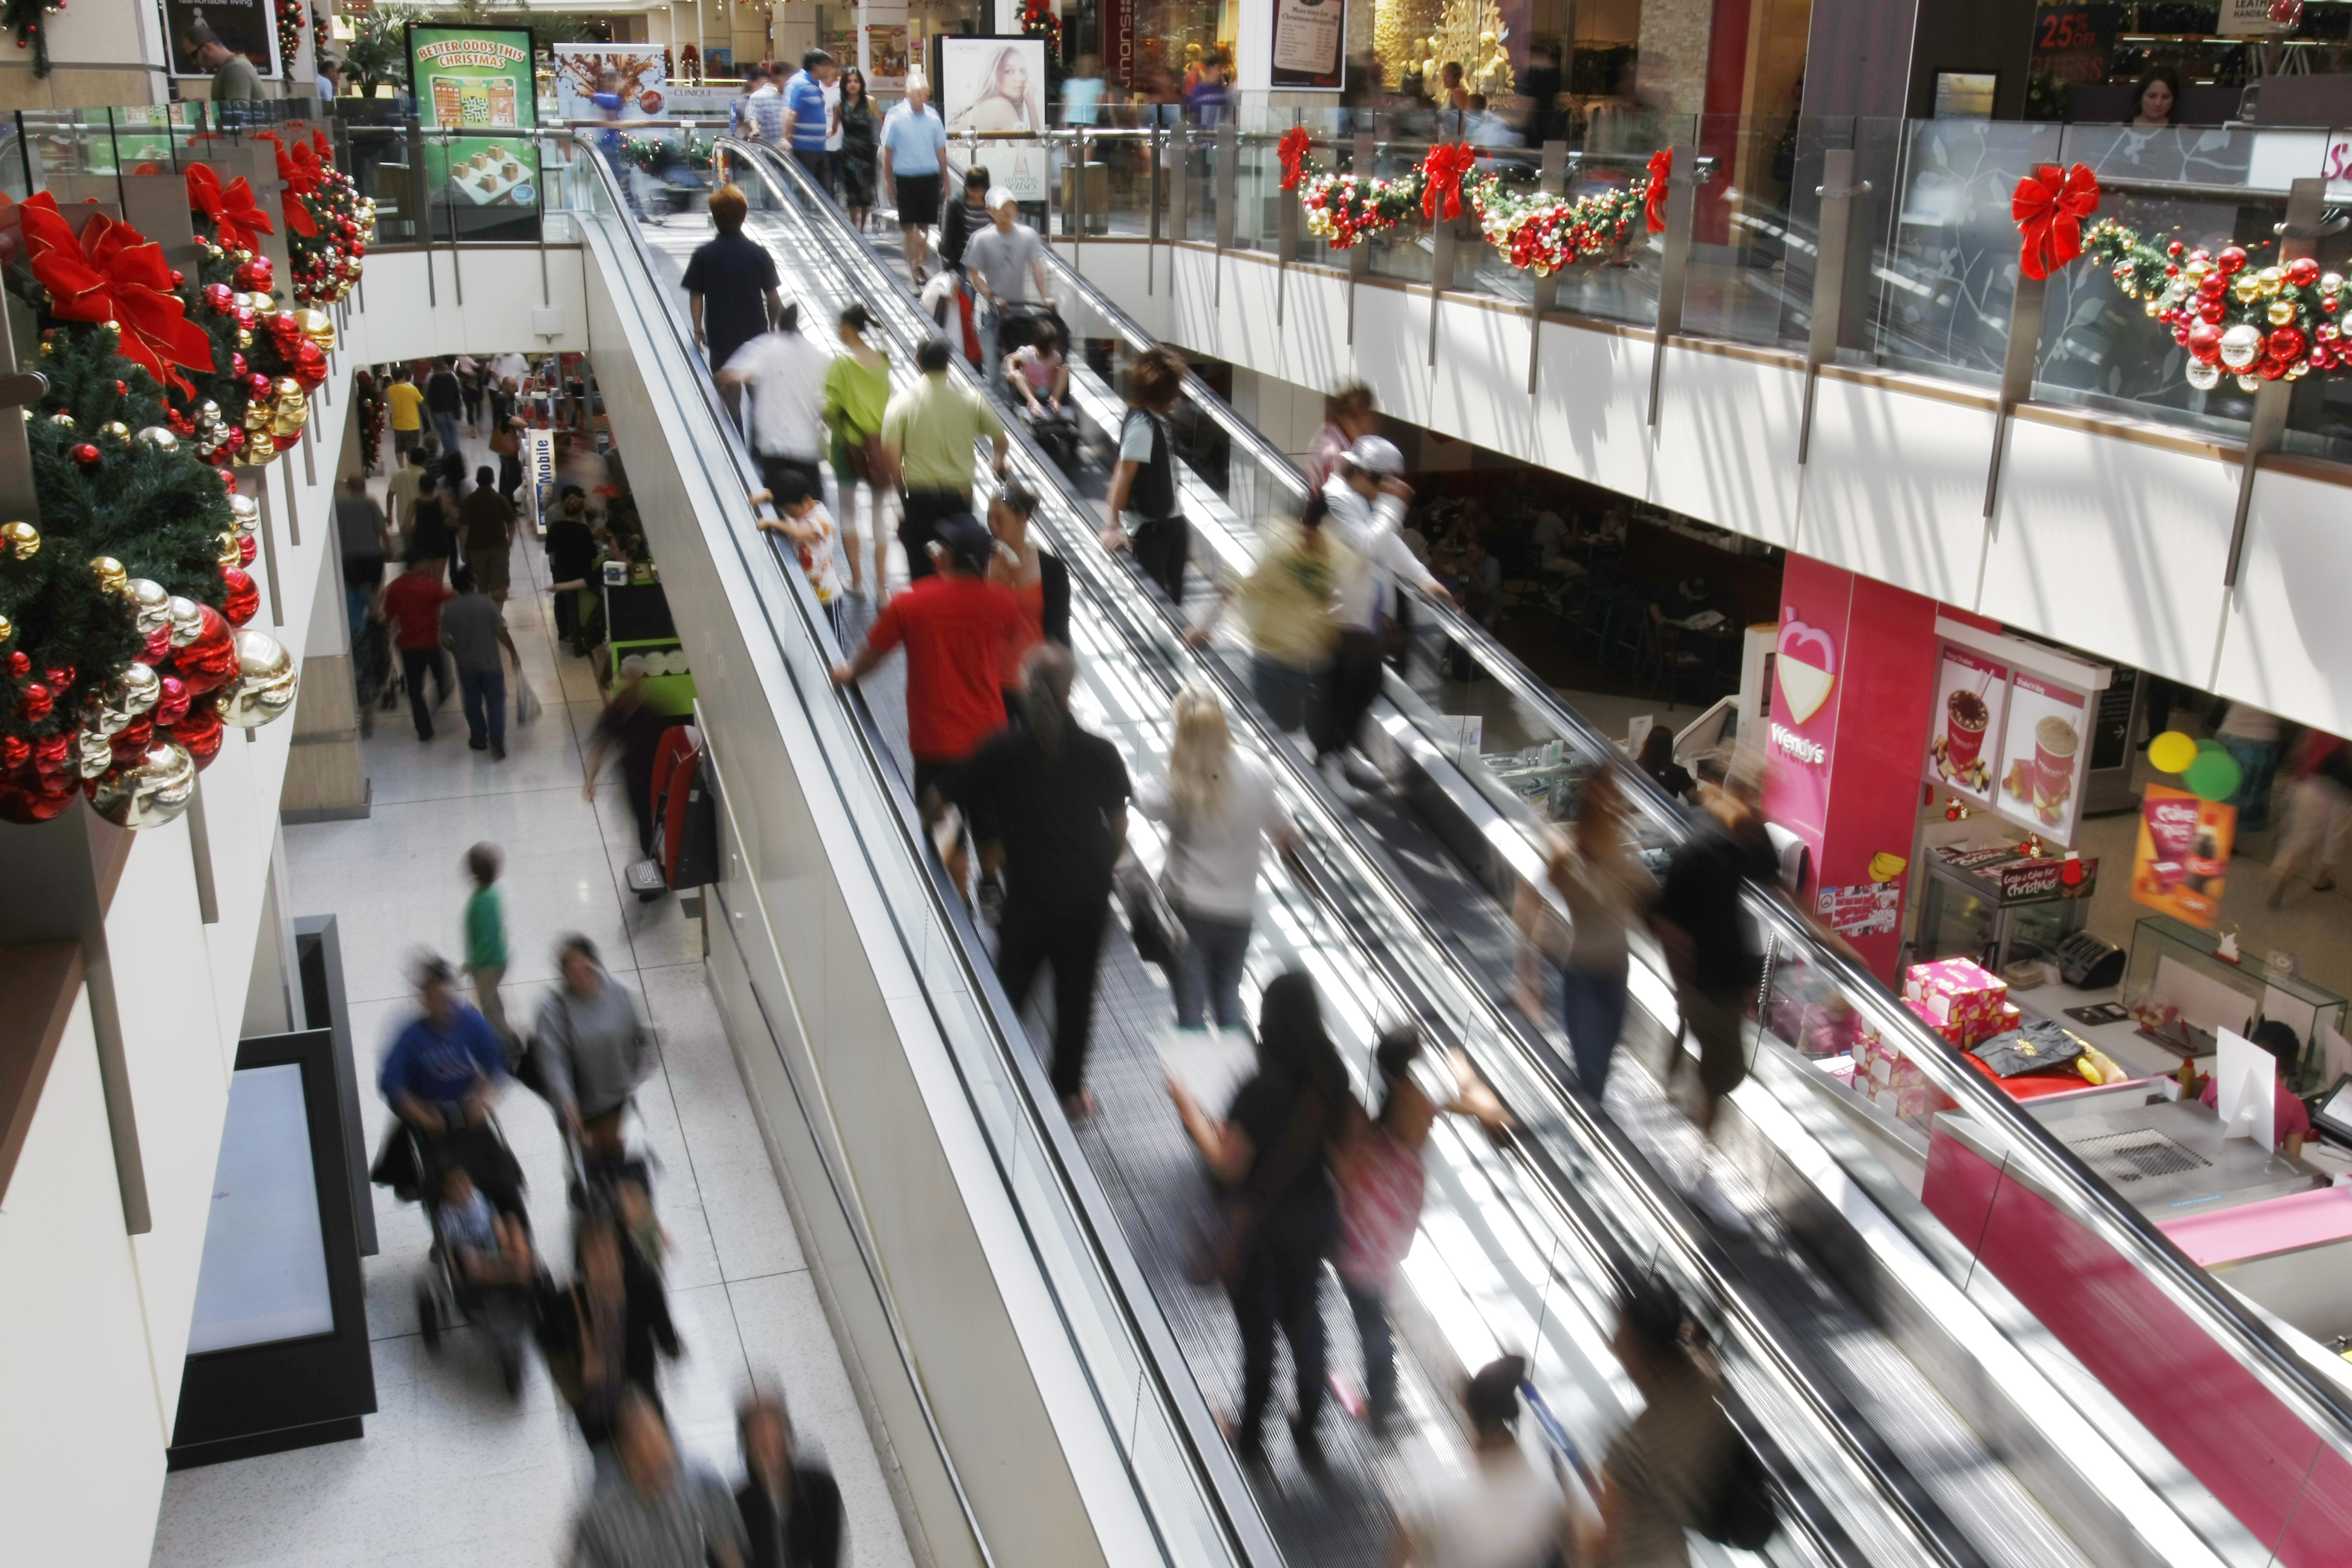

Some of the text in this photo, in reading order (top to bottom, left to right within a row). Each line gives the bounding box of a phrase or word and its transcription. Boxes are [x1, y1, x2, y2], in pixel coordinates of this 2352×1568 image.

[1282, 13, 1337, 27] Christmas shopping
[2233, 10, 2267, 19] HANDBA
[417, 40, 525, 62] BETTER ODDS THIS
[439, 53, 506, 68] CHRISTMAS
[536, 440, 552, 483] Mobile
[1771, 722, 1824, 764] Wendy's
